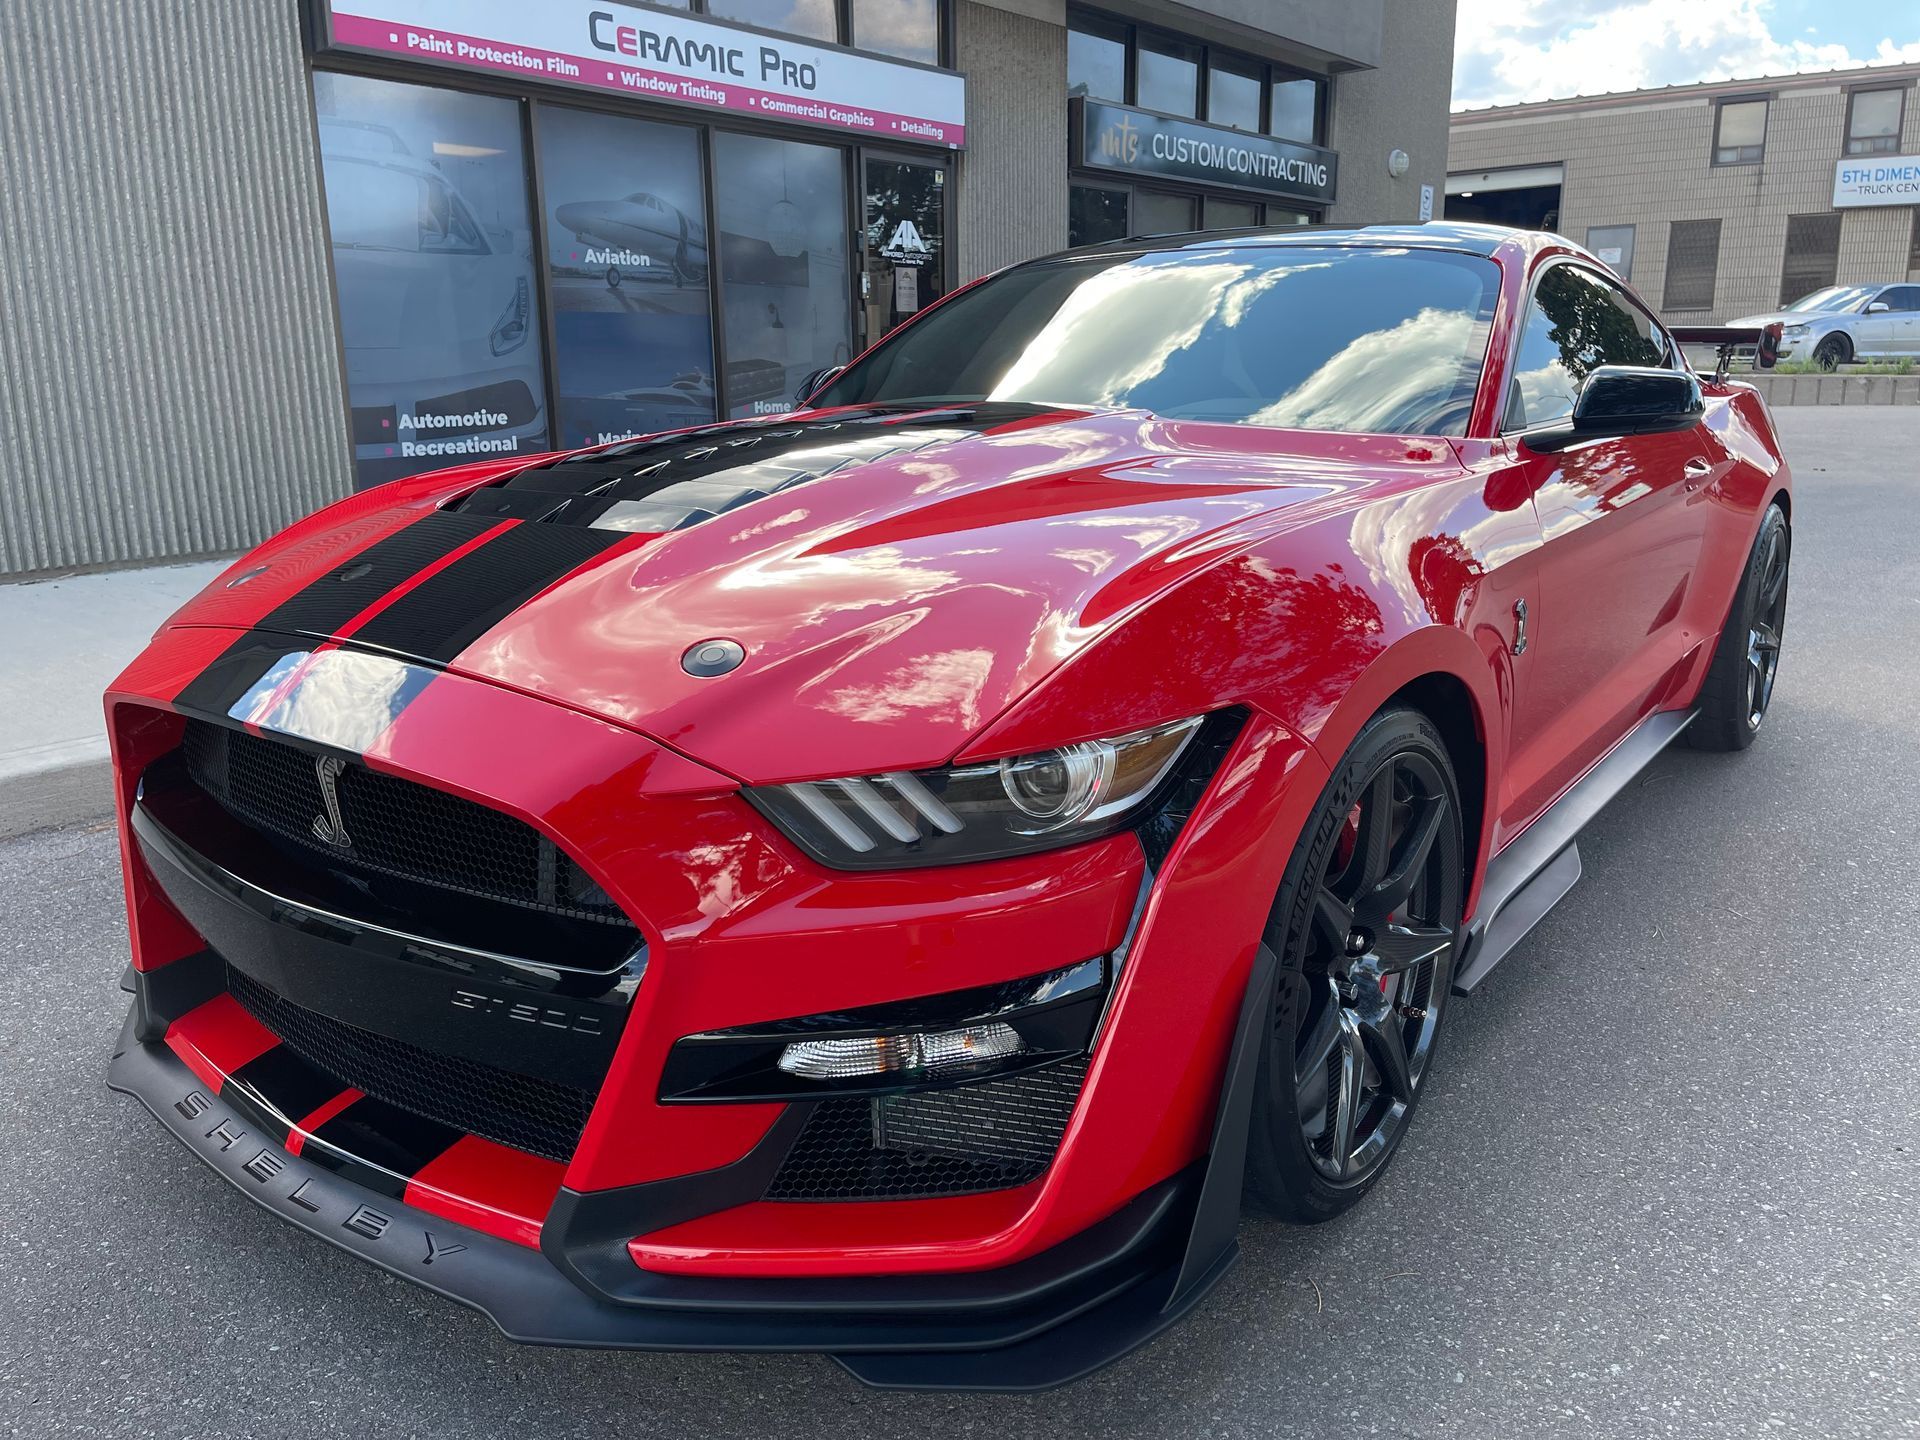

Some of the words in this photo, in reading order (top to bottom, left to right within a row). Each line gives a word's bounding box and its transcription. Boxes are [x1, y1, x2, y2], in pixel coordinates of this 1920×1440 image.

[407, 32, 454, 55] Paint
[457, 41, 543, 71] Protection
[546, 57, 580, 77] Film
[588, 11, 744, 77] CERAMIC
[760, 46, 816, 91] PRO
[620, 71, 678, 94] Window
[680, 82, 726, 104] Tinting
[760, 96, 827, 119] Commercial
[829, 109, 875, 127] Graphics
[901, 120, 944, 140] Detailing
[1152, 133, 1224, 169] CUSTOM
[1226, 147, 1327, 187] CONTRACTING
[1842, 169, 1871, 183] 5TH
[1858, 184, 1894, 194] TRUCK
[1896, 183, 1920, 193] CEN
[584, 247, 650, 266] Aviation
[754, 401, 791, 414] Home
[399, 408, 508, 430] Automotive
[401, 436, 518, 457] Recreational
[598, 429, 649, 445] Mari
[1290, 807, 1338, 938] MICHELIN
[173, 1090, 468, 1265] SHELBY
